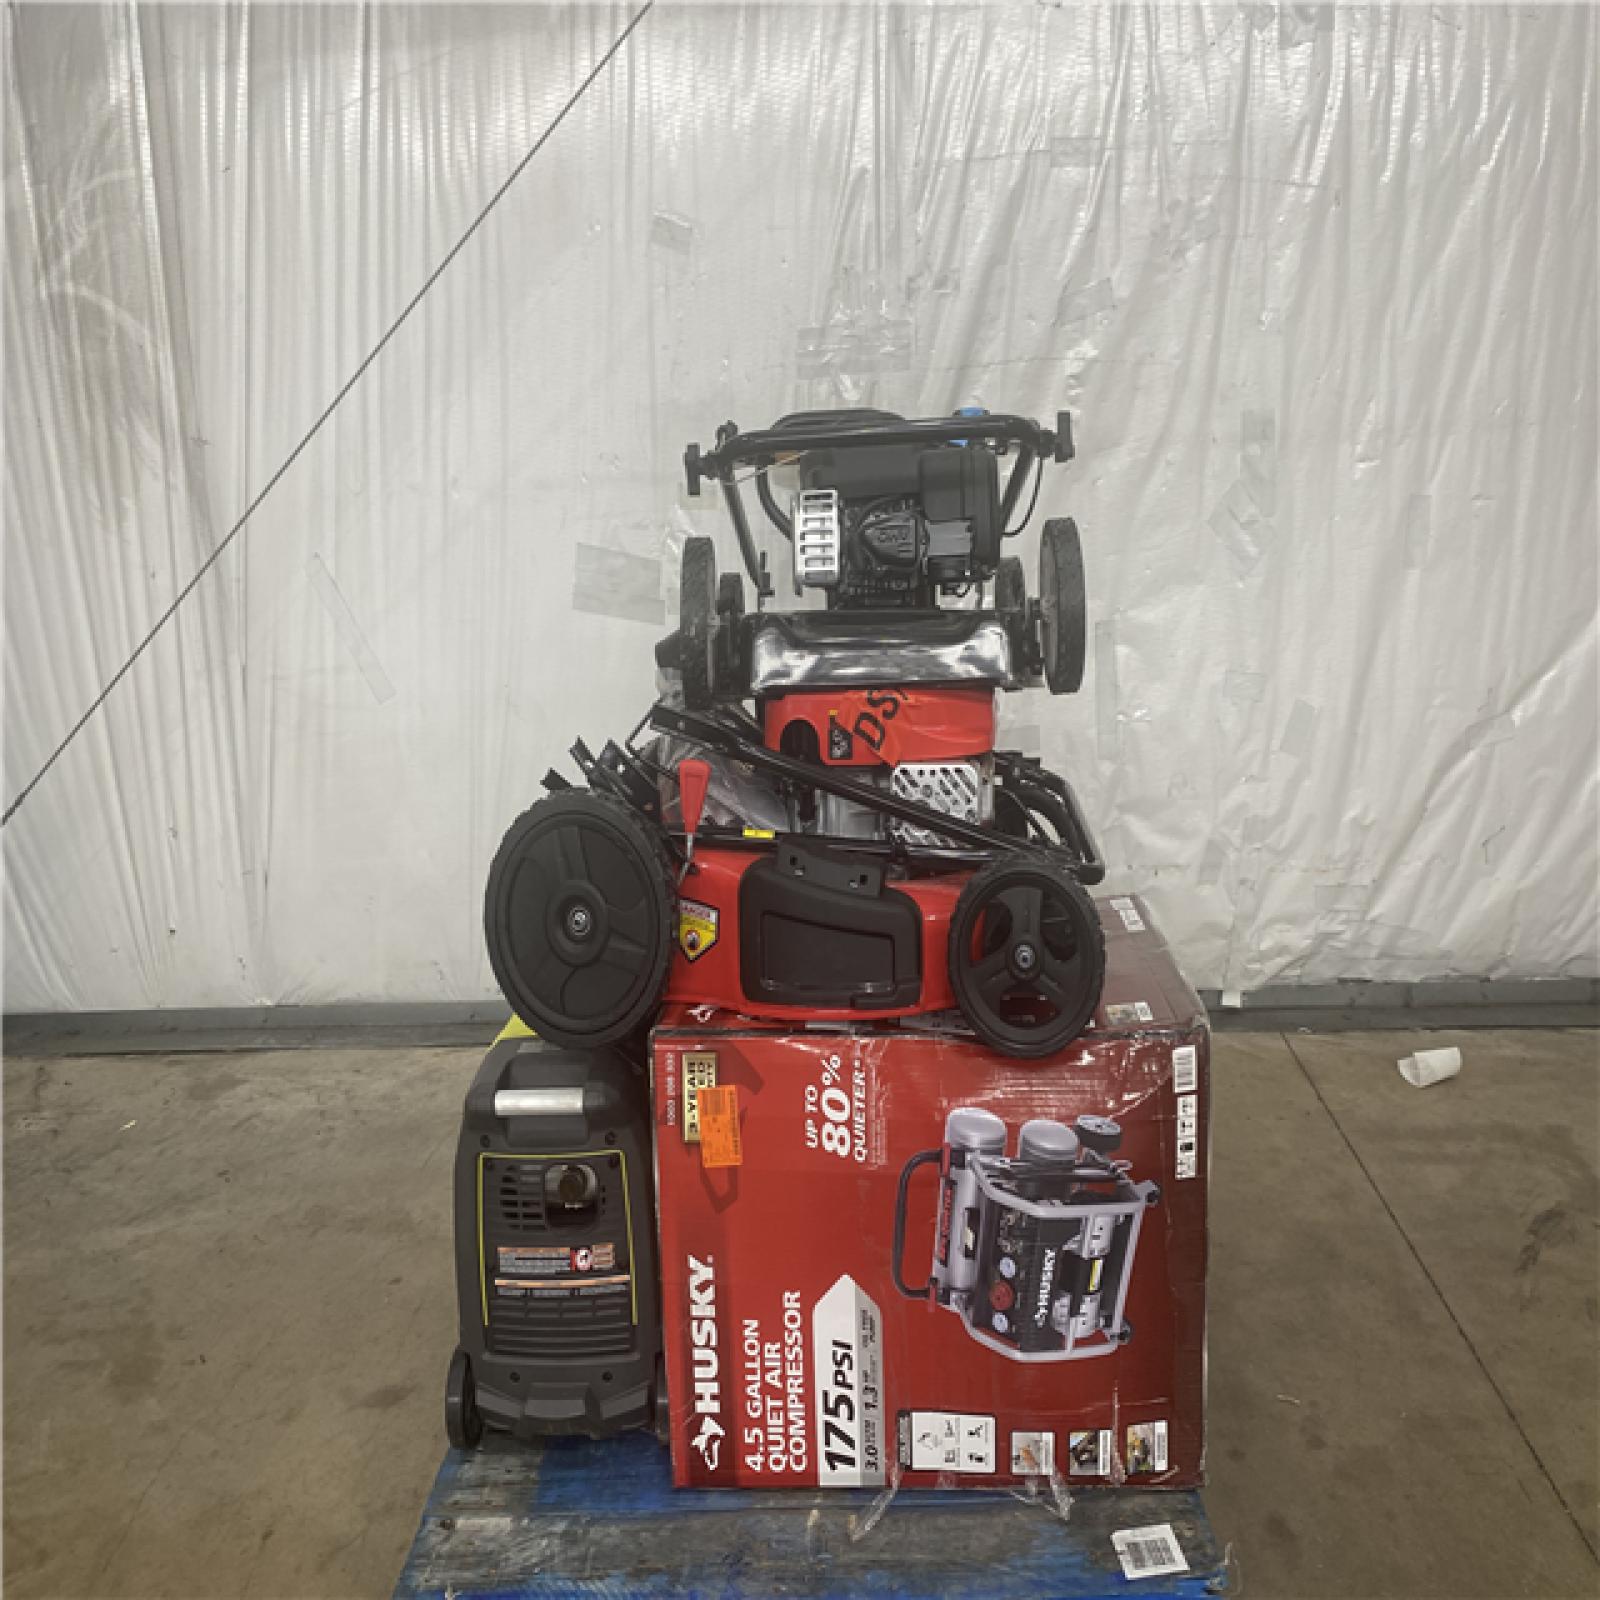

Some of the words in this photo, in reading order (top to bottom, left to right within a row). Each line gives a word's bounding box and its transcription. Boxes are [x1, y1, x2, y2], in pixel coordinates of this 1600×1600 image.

[805, 1085, 818, 1113] TO
[821, 1054, 851, 1158] 80%
[805, 1119, 818, 1148] UP
[687, 1254, 721, 1414] HUSKY
[742, 1319, 762, 1419] GALLON
[764, 1342, 784, 1388] AIR
[782, 1290, 808, 1473] COMPRESSOR
[862, 1386, 878, 1411] 1.3
[744, 1428, 764, 1472] 4.5
[766, 1395, 786, 1473] QUIET
[864, 1443, 879, 1473] 3.0
